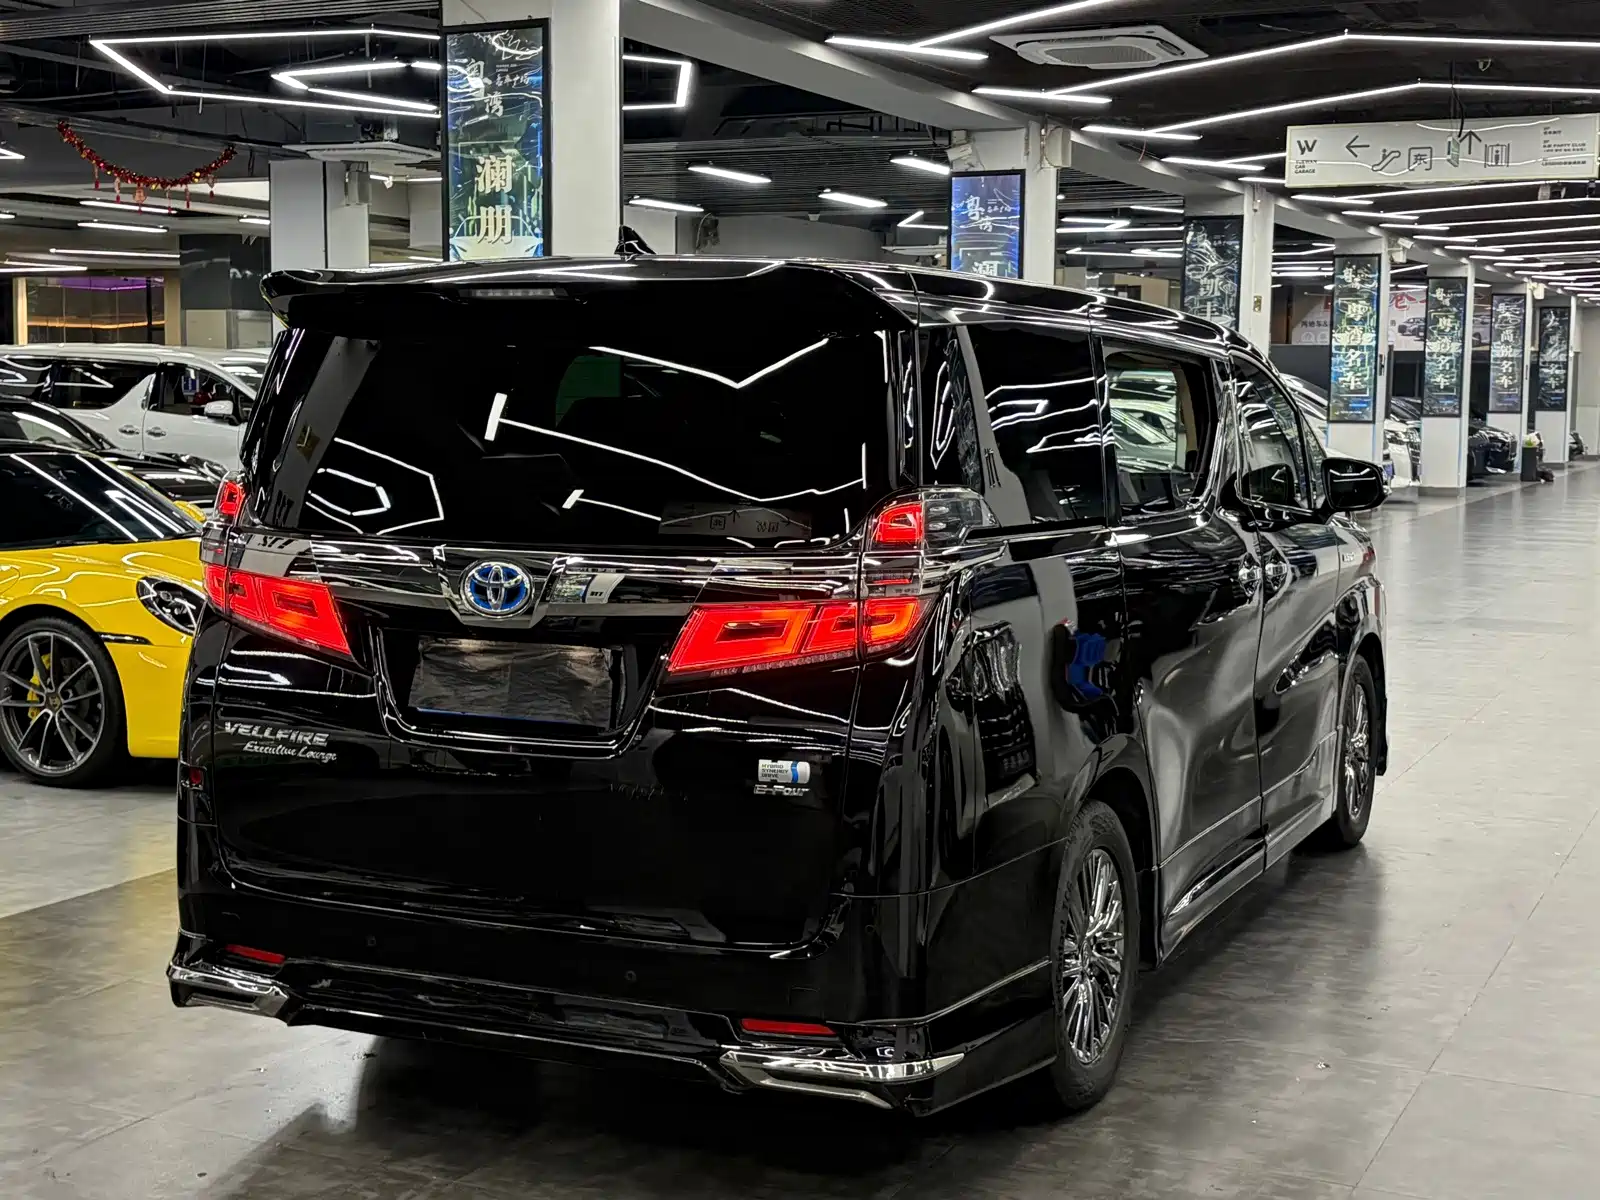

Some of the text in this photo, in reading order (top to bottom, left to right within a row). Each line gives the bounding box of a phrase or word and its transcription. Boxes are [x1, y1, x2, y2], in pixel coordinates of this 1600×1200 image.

[224, 721, 330, 747] VELLFIRE
[243, 740, 338, 763] Executive Lounge
